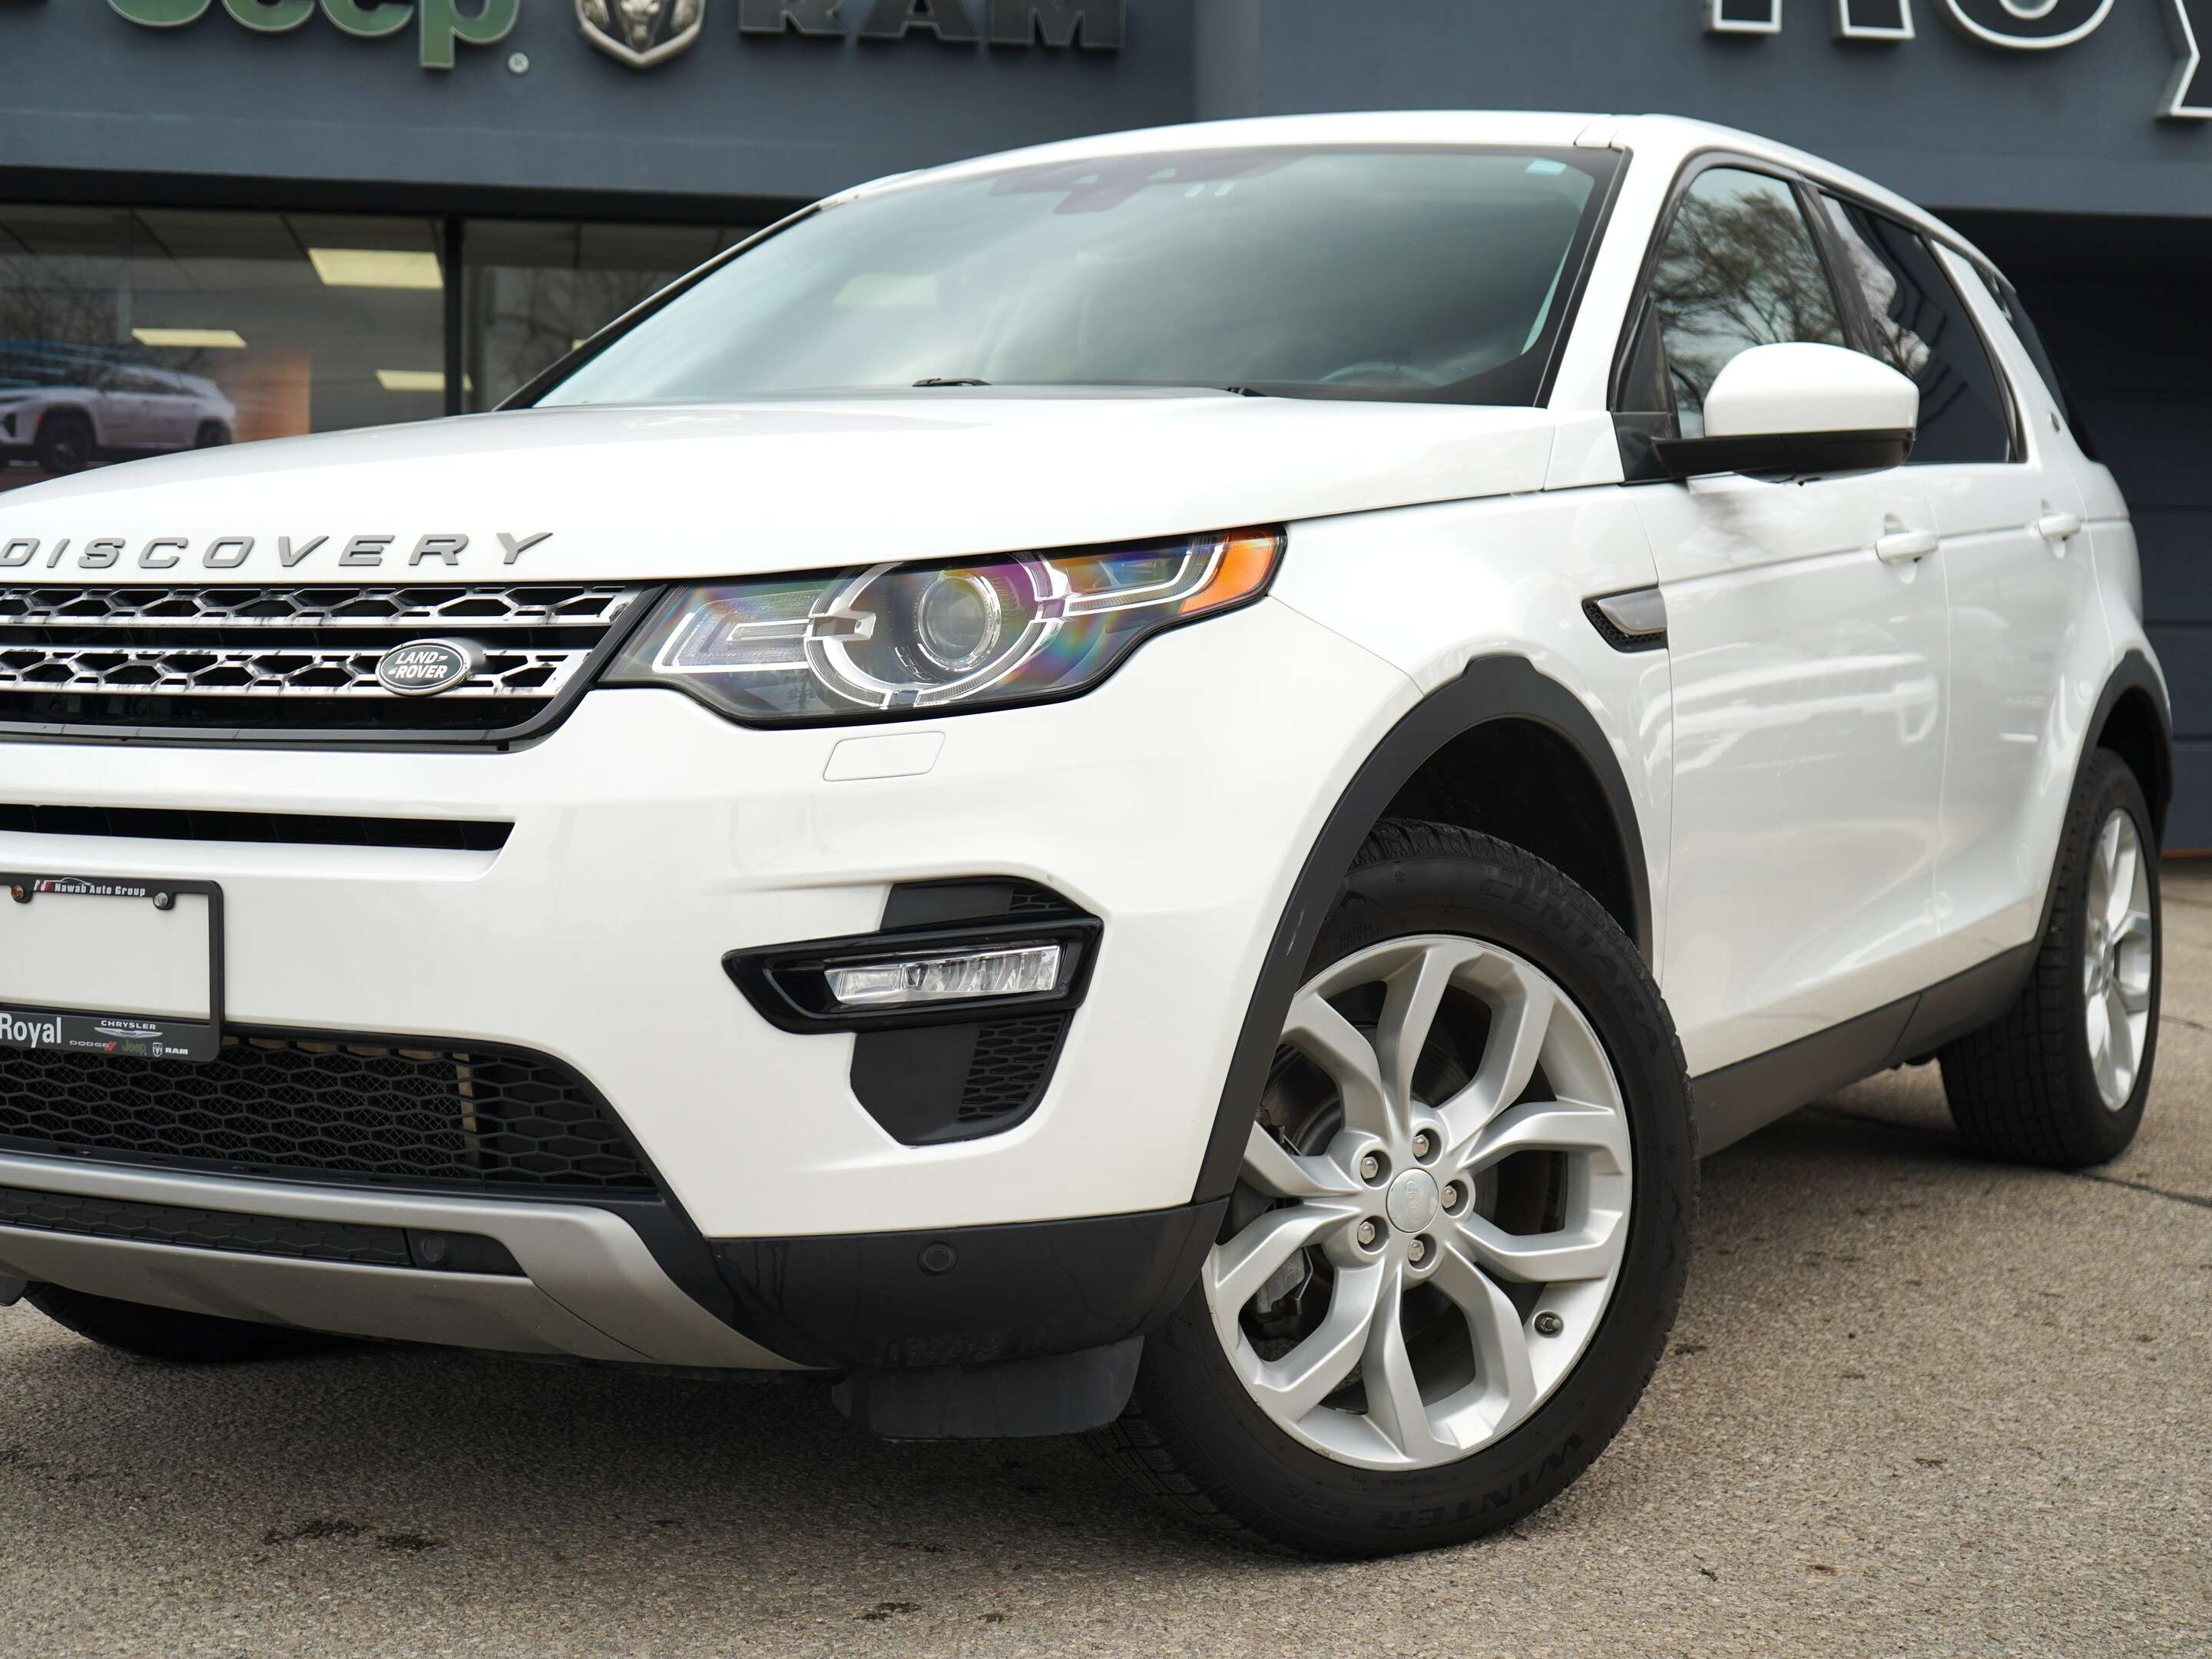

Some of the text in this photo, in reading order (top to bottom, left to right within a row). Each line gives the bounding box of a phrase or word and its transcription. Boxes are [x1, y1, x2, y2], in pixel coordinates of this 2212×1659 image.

[0, 532, 553, 568] DISCOVERY
[396, 651, 439, 664] LAND
[395, 665, 448, 678] ROVER
[55, 883, 146, 897] Nawab Auto Group
[0, 1012, 61, 1048] Royal
[101, 1020, 156, 1030] CHRYSLER
[121, 1040, 146, 1054] Jeep
[1371, 1430, 1584, 1530] WINTER
